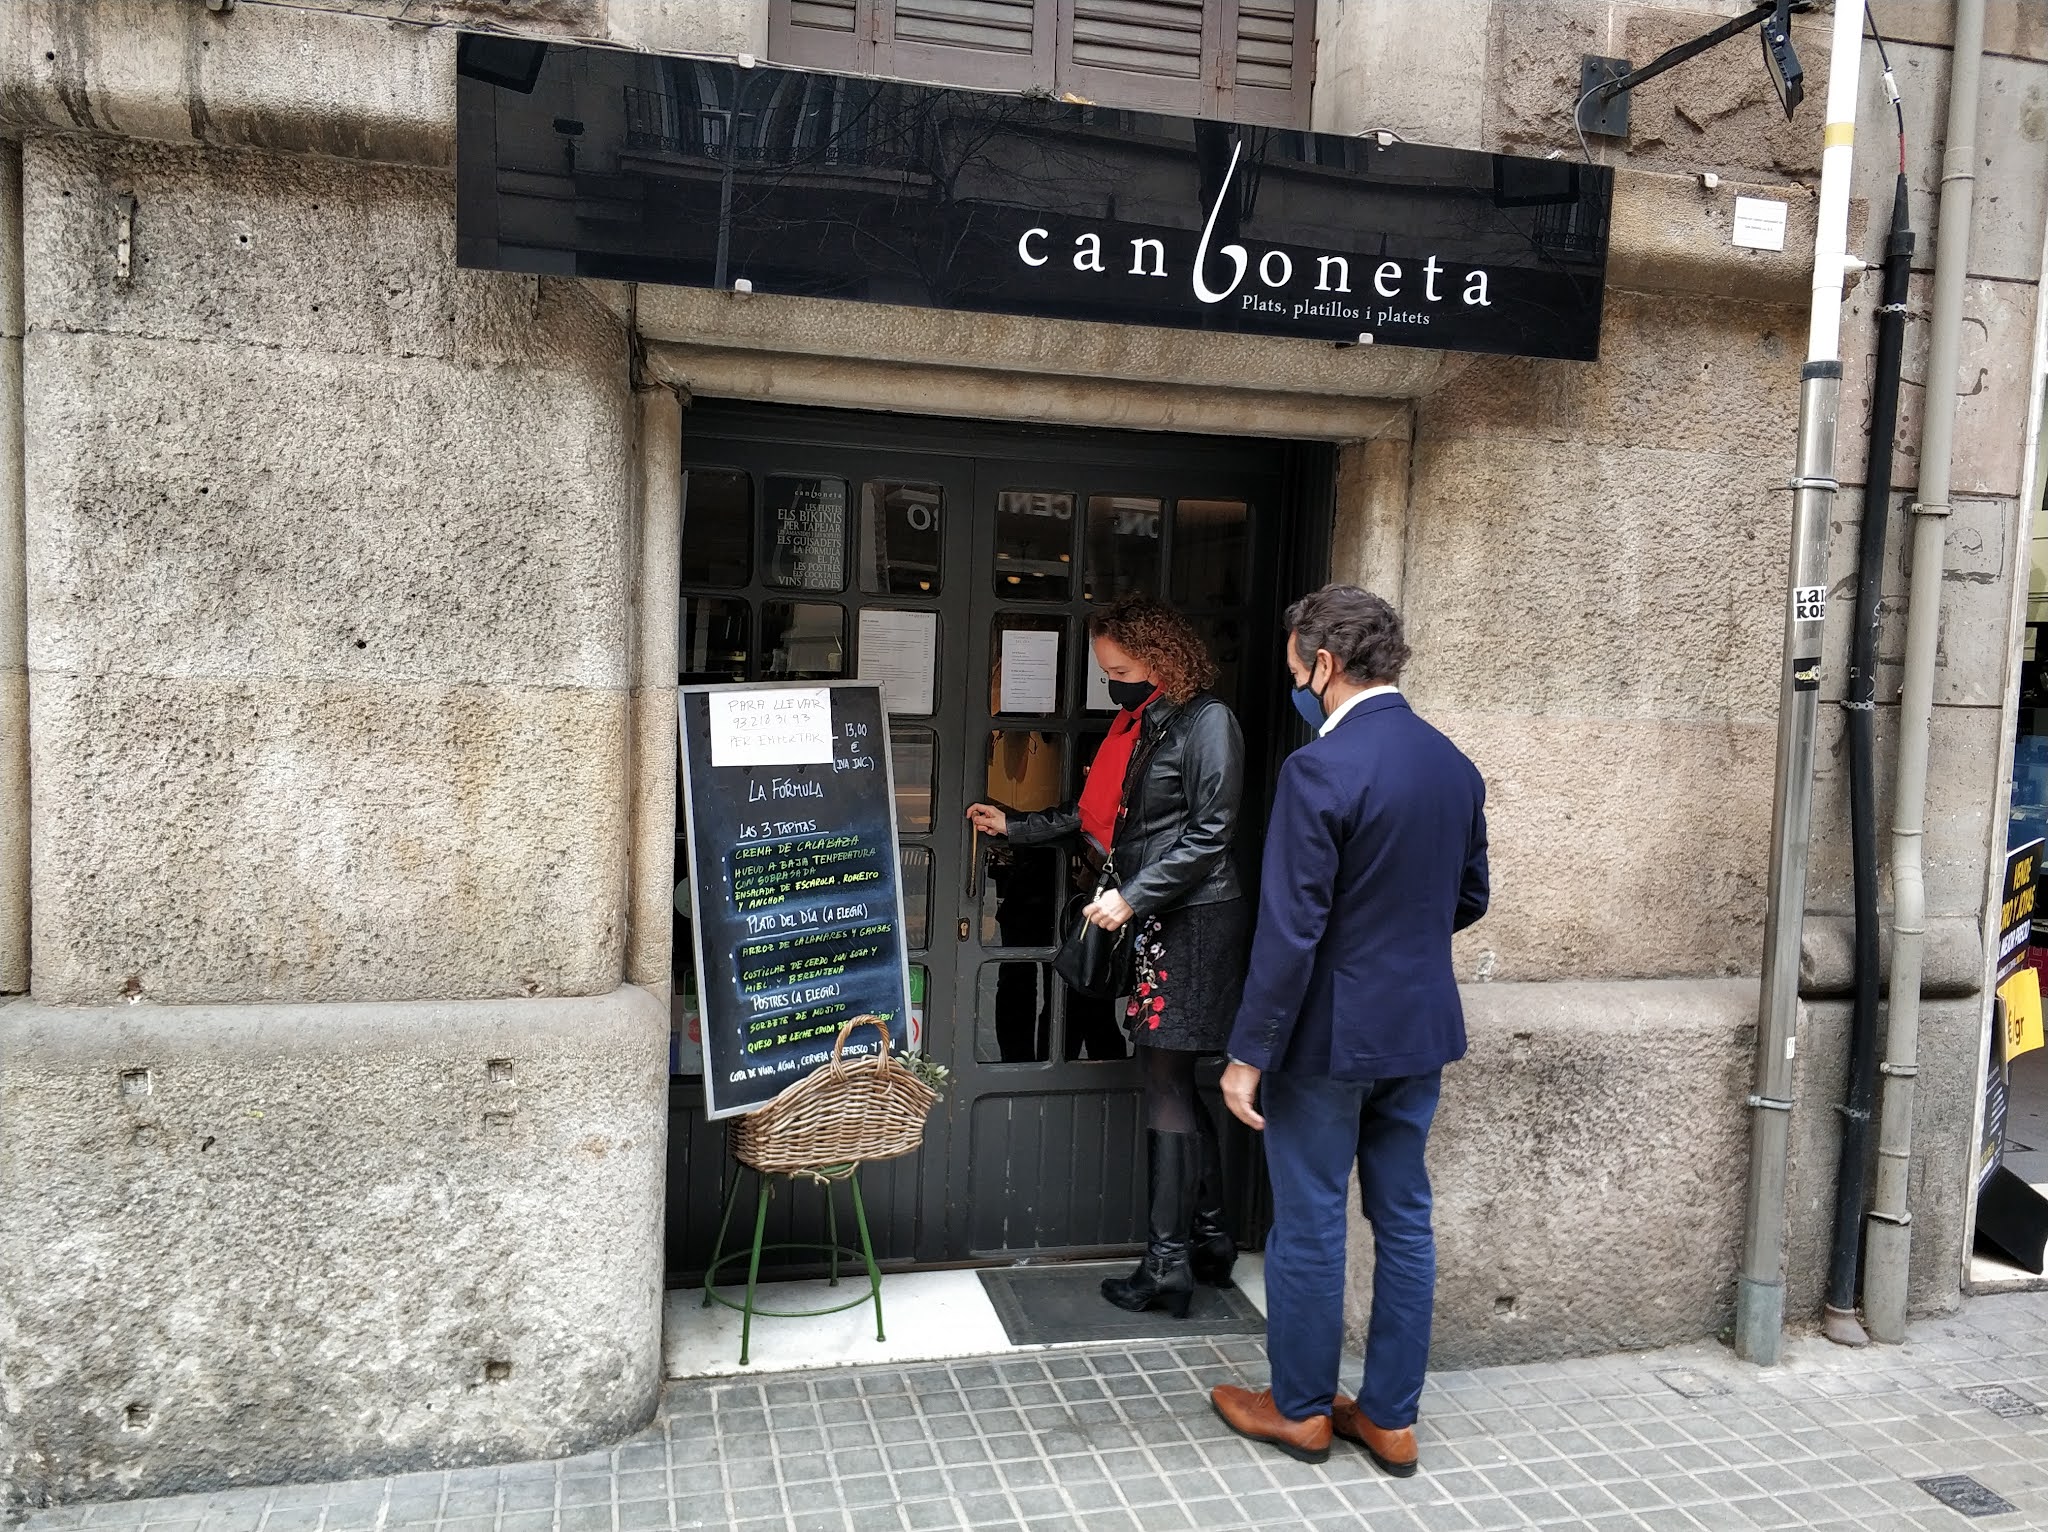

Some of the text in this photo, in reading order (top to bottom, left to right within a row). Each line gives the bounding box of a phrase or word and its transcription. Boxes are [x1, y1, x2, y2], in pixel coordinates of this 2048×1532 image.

[1242, 294, 1430, 326] Plats, platillos i platets
[778, 509, 842, 523] ELS BIKINIS
[784, 521, 841, 533] PER TAPEJAR
[777, 535, 791, 544] ELS
[793, 536, 842, 548] GUISADETS
[793, 545, 803, 553] LA
[793, 562, 841, 573] LES POSTRES
[830, 556, 840, 564] PA
[778, 576, 802, 586] VINS
[811, 578, 840, 589] CAVES
[804, 571, 841, 580] COCKTAILS
[728, 698, 825, 712] PARA LLEVAR
[733, 717, 747, 729] 93
[850, 741, 861, 753] €
[833, 758, 849, 773] (IVA
[749, 780, 767, 802] LA
[740, 824, 757, 838] LAS
[761, 822, 771, 838] 3
[735, 835, 859, 860] CREMA DE CALABAZA
[735, 847, 876, 879] HUEVO A BAJA TEMPERATURA
[735, 867, 817, 890] CON SOBRASADA
[735, 887, 775, 900] ENSALADA
[780, 883, 791, 893] DE
[843, 871, 879, 883] ROMESCO
[738, 895, 785, 912] Y ANCHOA
[746, 914, 776, 934] PLATO
[779, 913, 797, 927] DEL
[799, 908, 818, 924] DÍA
[742, 924, 892, 957] ARROZ DE CALAMARES Y GAMBAS
[790, 959, 803, 971] DE
[804, 956, 829, 968] CERDO
[849, 949, 869, 959] SOJA
[871, 946, 878, 957] Y
[788, 965, 845, 985] BERENJENA
[750, 993, 789, 1012] POSTRES
[750, 1016, 789, 1034] SORBETE
[795, 1011, 807, 1020] DE
[747, 1038, 773, 1054] QUESO
[777, 1034, 788, 1045] DE
[789, 1028, 814, 1043] LECHE
[814, 1022, 835, 1036] CRUDA
[730, 1070, 747, 1083] COPA
[748, 1068, 756, 1079] DE
[801, 1050, 829, 1066] CERVEZA
[871, 1042, 877, 1052] Y
